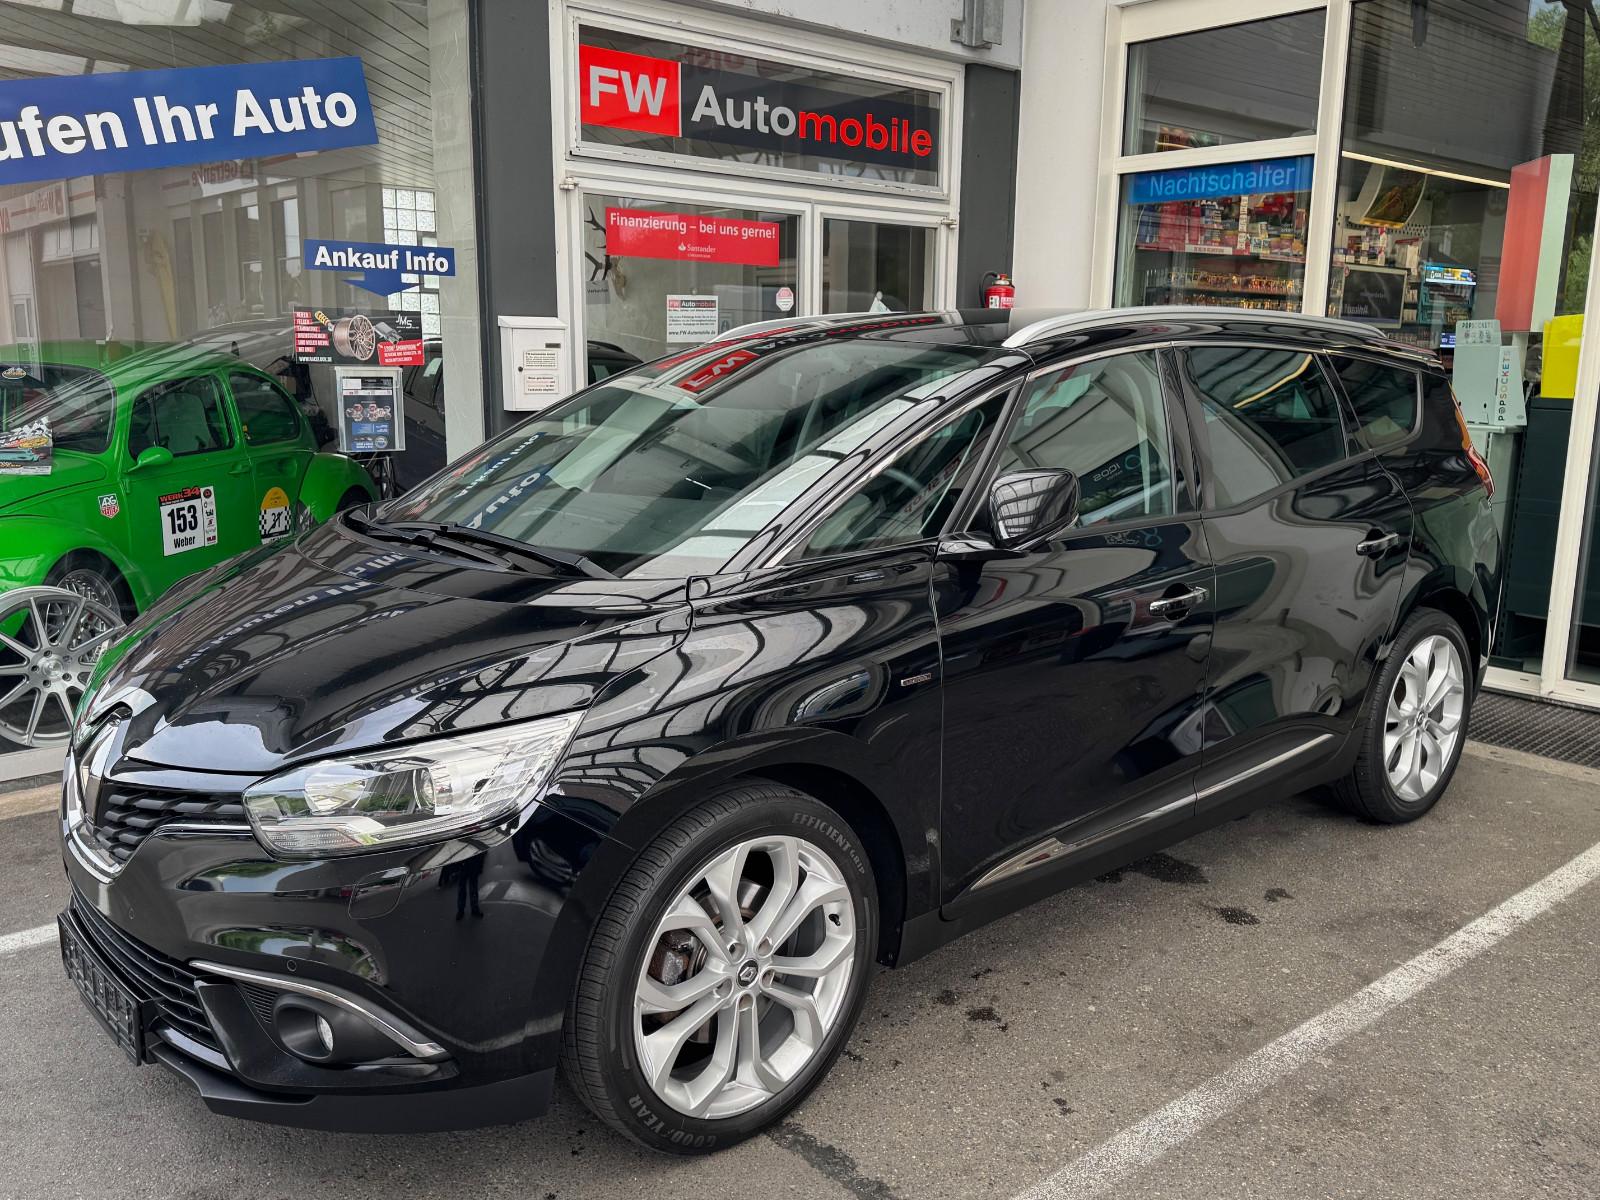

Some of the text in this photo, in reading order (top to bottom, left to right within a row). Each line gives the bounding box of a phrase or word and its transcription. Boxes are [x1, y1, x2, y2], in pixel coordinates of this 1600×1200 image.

[133, 95, 219, 145] Ihr
[233, 86, 357, 137] Auto
[589, 65, 933, 157] FW Automobile
[1149, 165, 1295, 197] Nachtschalter
[610, 212, 687, 234] Finanzierung
[699, 219, 716, 234] bei
[719, 224, 739, 237] uns
[741, 226, 776, 240] gerne!
[314, 245, 449, 273] Ankauf Info
[687, 244, 717, 253] Santander
[395, 313, 412, 329] JMS
[167, 504, 199, 535] 153
[173, 536, 196, 549] Weber
[792, 812, 865, 874] EFFICIENT GRIP
